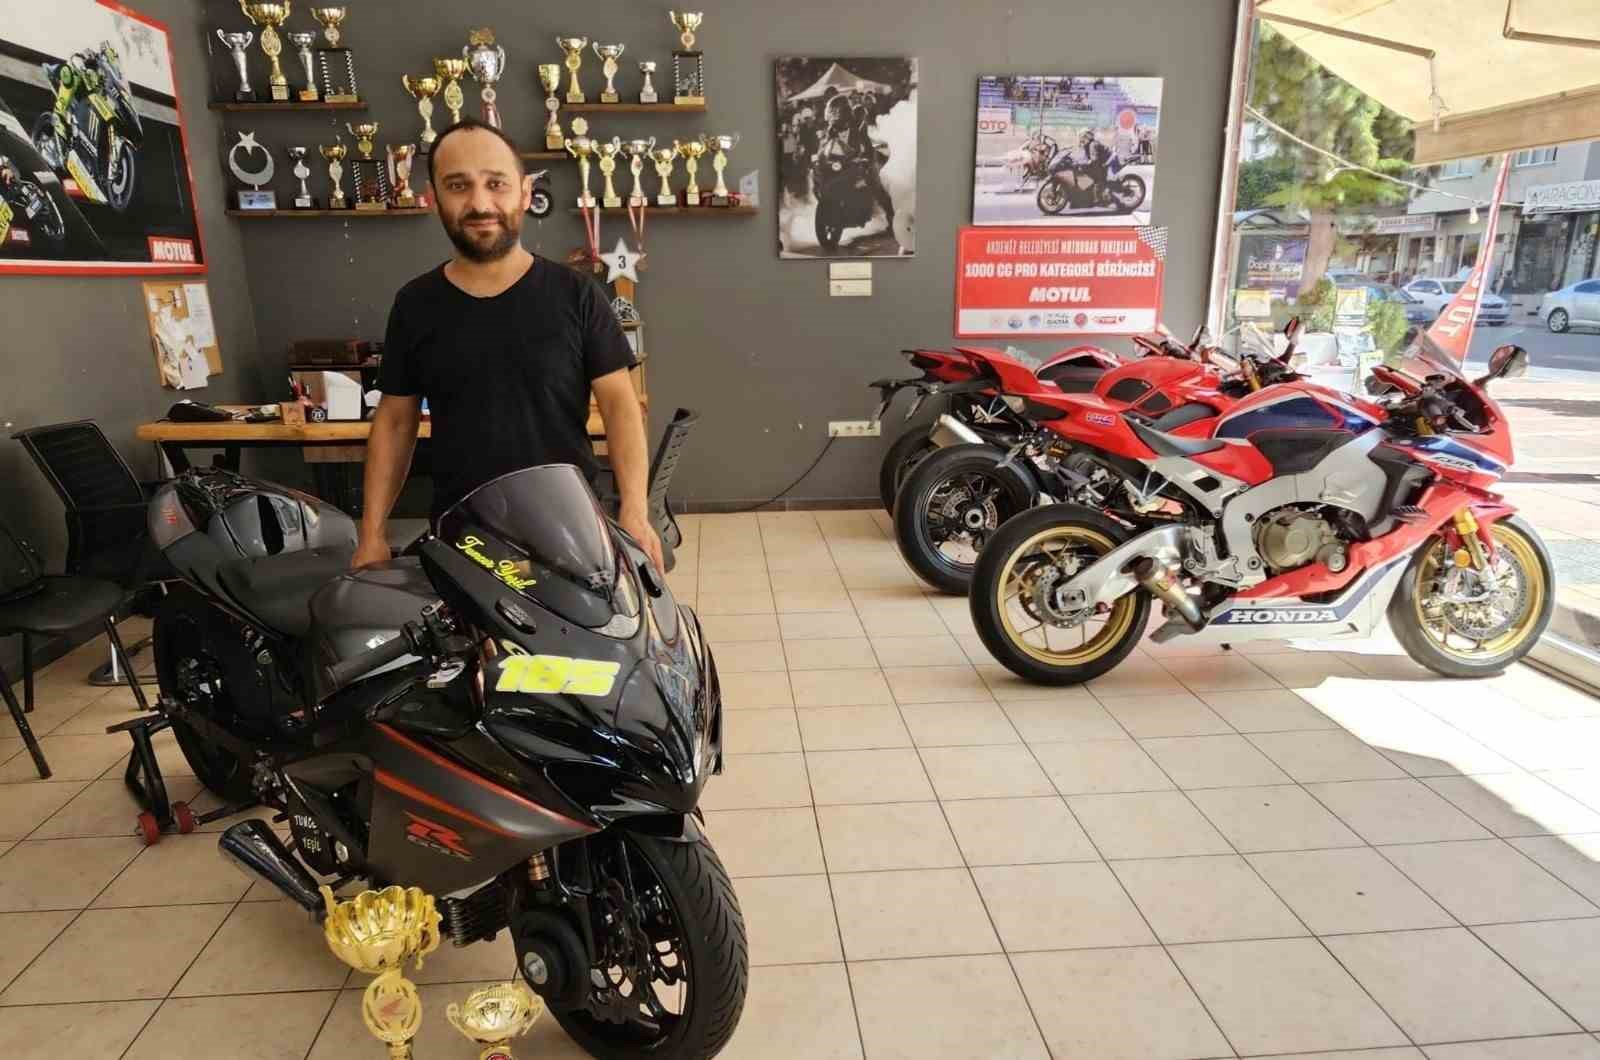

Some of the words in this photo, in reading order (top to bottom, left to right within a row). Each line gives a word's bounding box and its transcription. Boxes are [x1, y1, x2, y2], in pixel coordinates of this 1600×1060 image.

[152, 240, 194, 262] MOTUL
[618, 255, 626, 269] 3
[965, 264, 994, 277] 1000
[1015, 263, 1038, 277] PRO
[1040, 259, 1094, 277] KATEGORİ
[1029, 287, 1092, 303] MOTUL
[1228, 609, 1338, 623] HONDA
